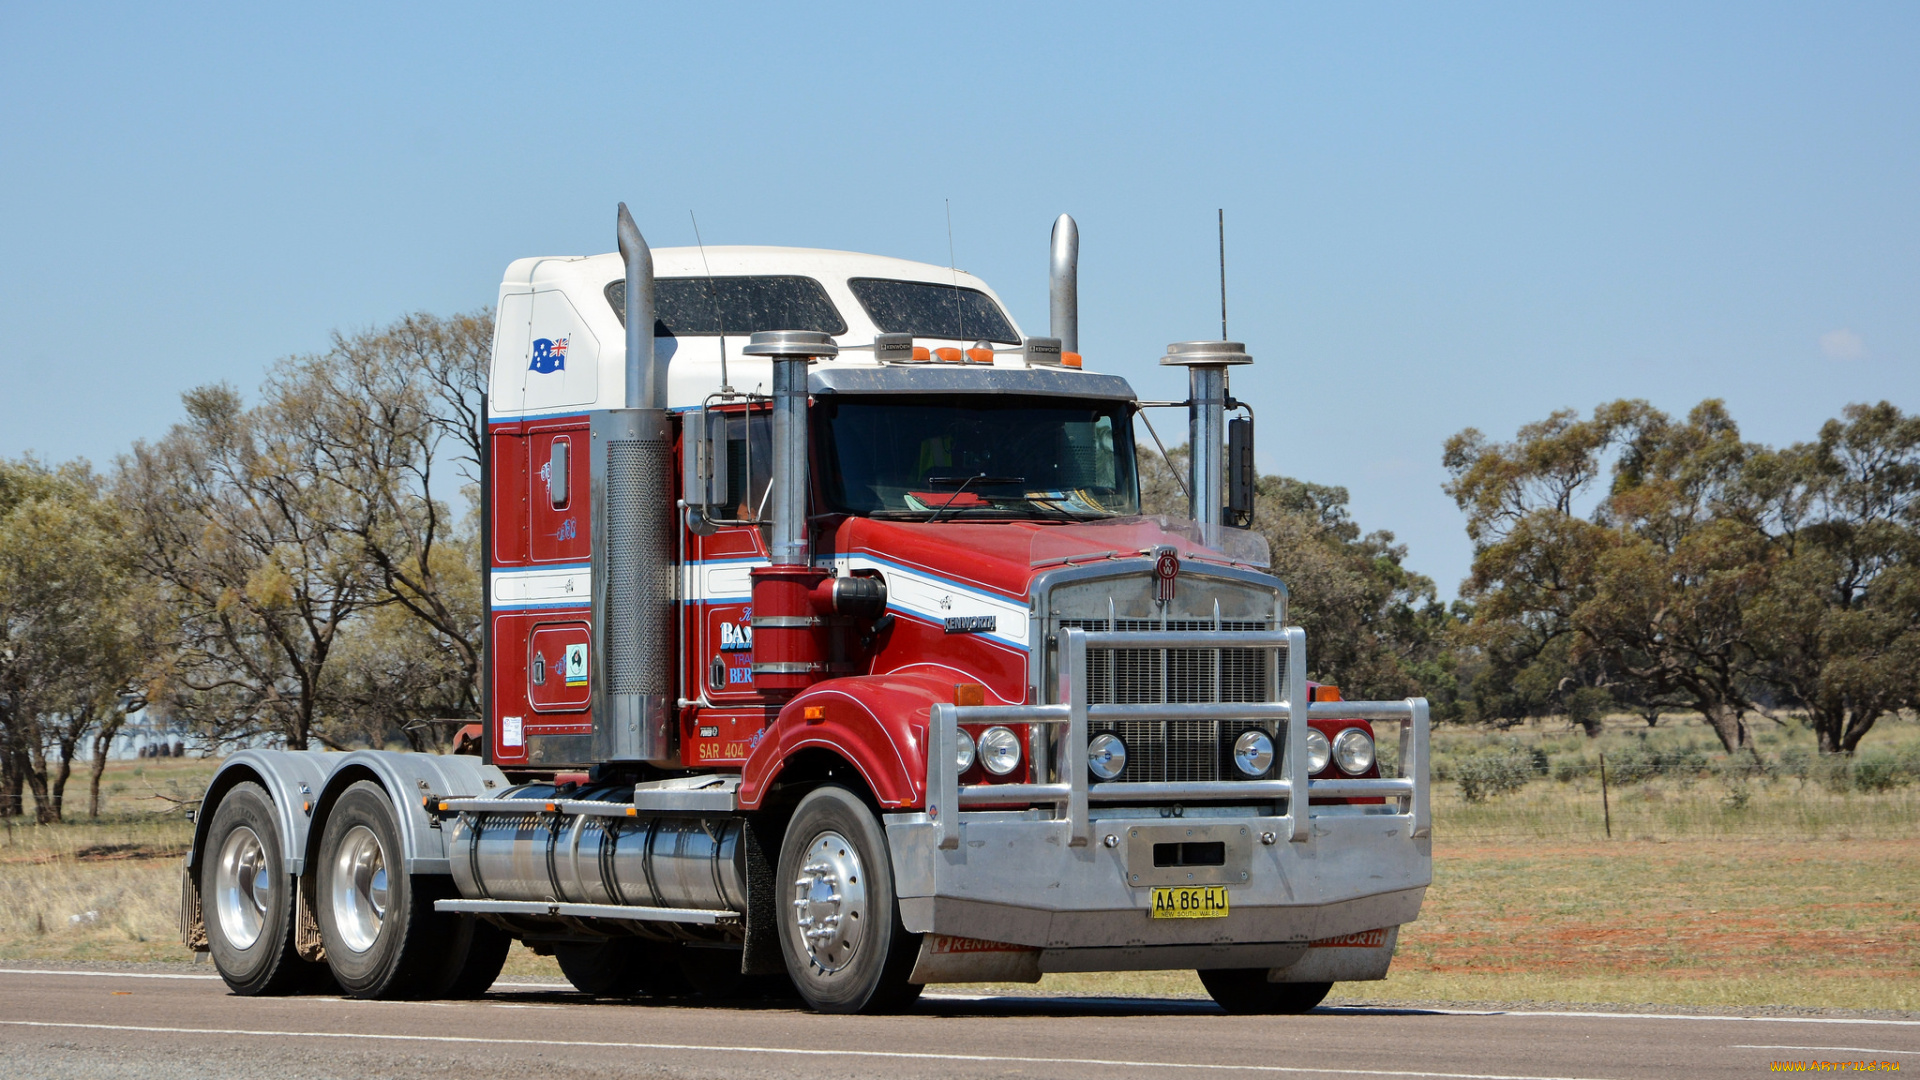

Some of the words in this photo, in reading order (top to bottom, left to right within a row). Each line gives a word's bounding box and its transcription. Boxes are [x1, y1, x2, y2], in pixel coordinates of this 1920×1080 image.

[944, 616, 996, 629] KENWORTH
[699, 743, 719, 758] SAR
[725, 743, 744, 757] 404
[1156, 891, 1175, 910] AA
[1180, 891, 1200, 910] 86
[1205, 890, 1225, 909] HJ
